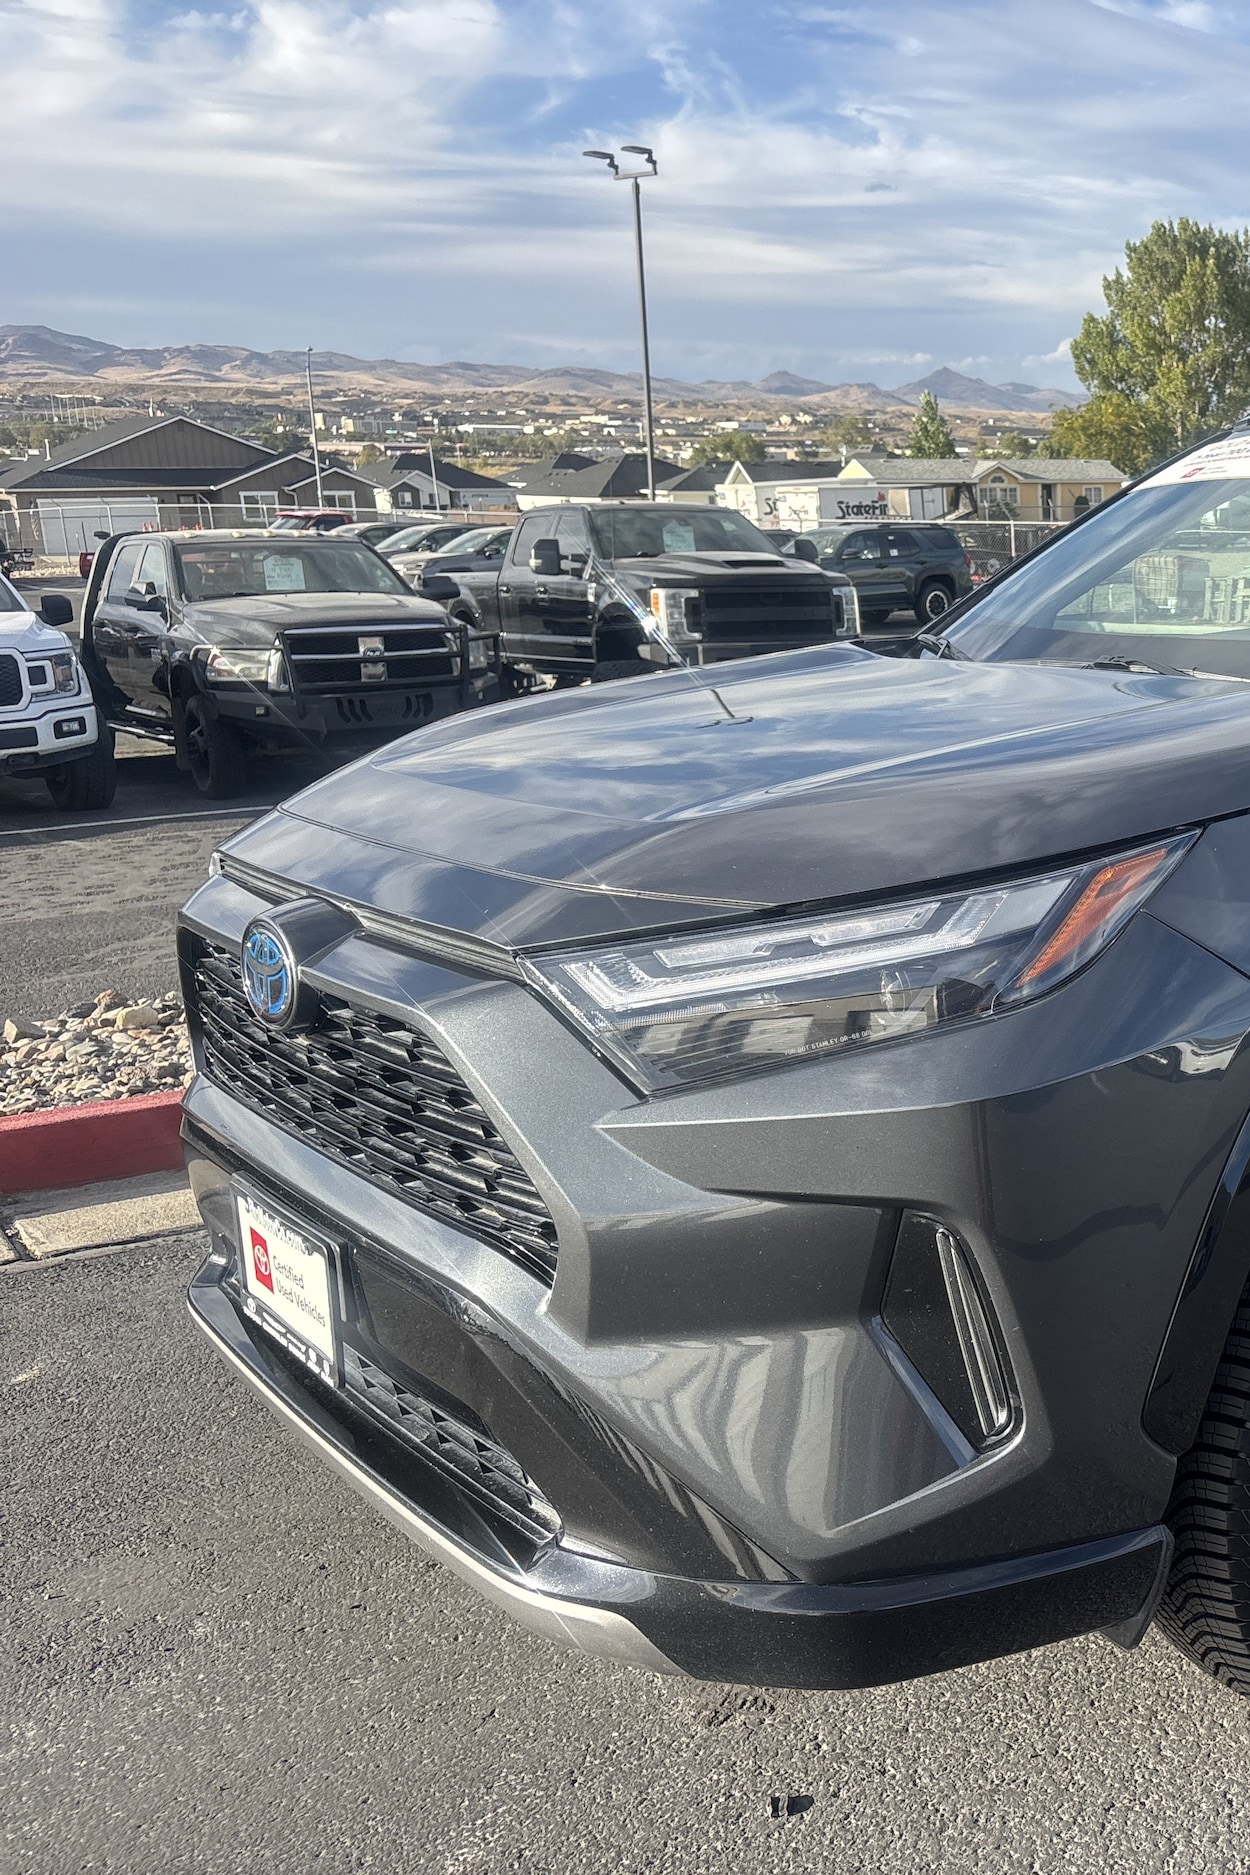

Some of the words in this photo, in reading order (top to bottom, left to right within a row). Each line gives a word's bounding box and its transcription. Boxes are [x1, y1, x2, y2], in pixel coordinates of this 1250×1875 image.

[811, 1038, 838, 1050] STANLEY
[273, 1255, 304, 1290] Certified
[276, 1277, 293, 1303] Used
[294, 1291, 325, 1327] Vehicles
